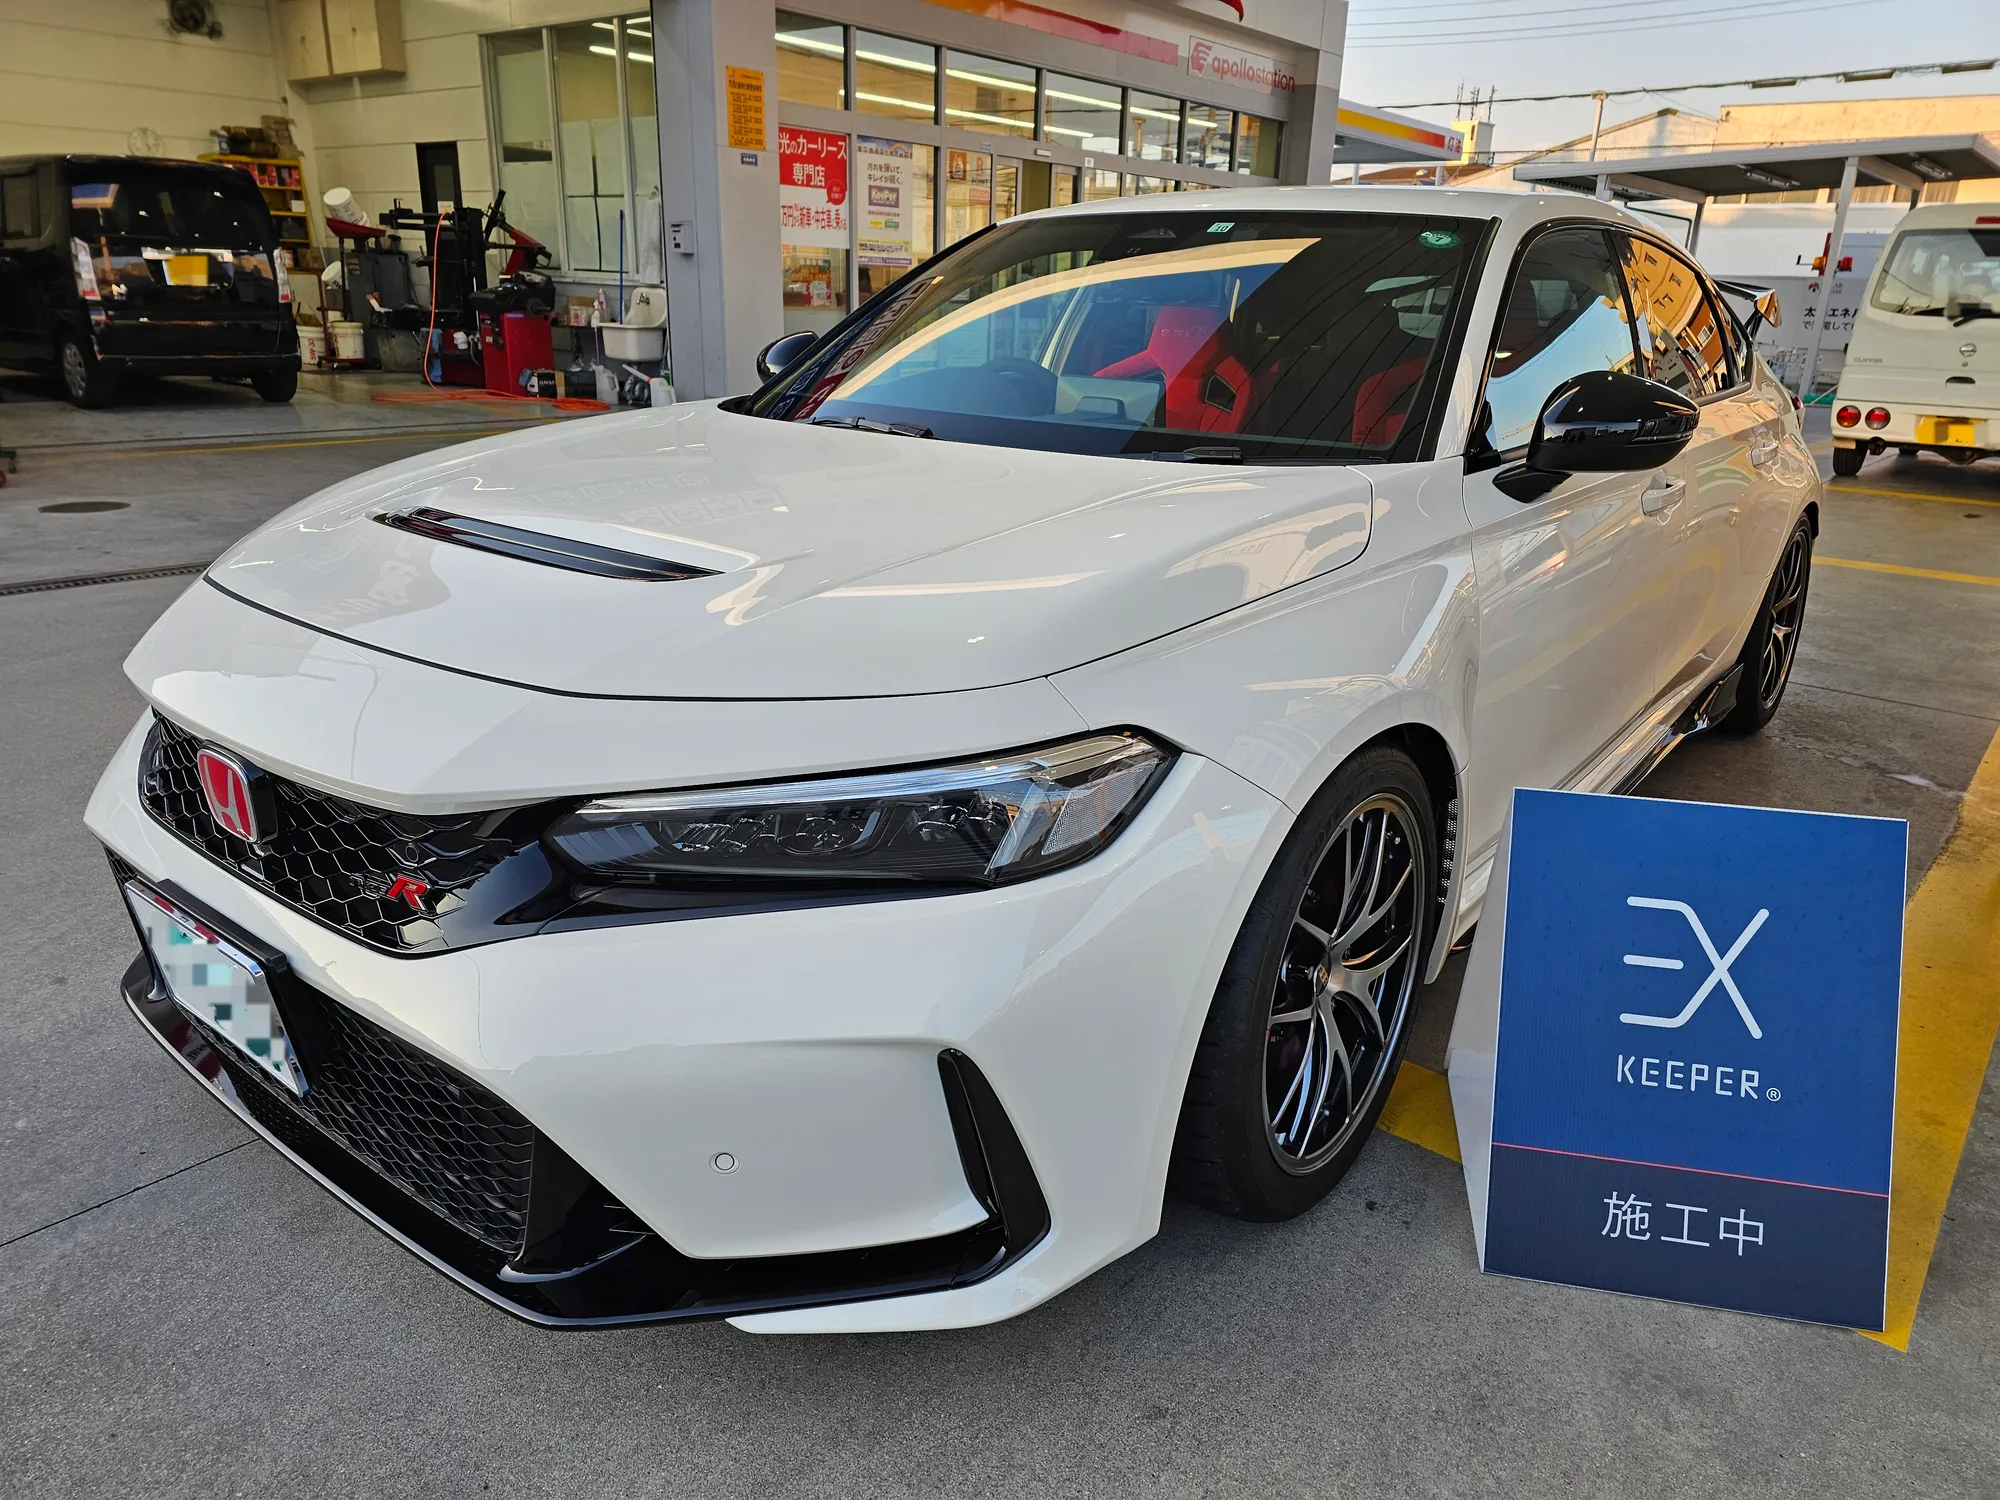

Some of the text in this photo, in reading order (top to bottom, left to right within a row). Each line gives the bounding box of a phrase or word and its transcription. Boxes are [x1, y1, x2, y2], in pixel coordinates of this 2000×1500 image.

[1211, 56, 1295, 92] apollostation
[779, 131, 847, 160] 光のカーリース
[792, 163, 826, 187] 専門店
[1803, 306, 1859, 318] 太エネ
[1601, 1190, 1764, 1257] 施工中
